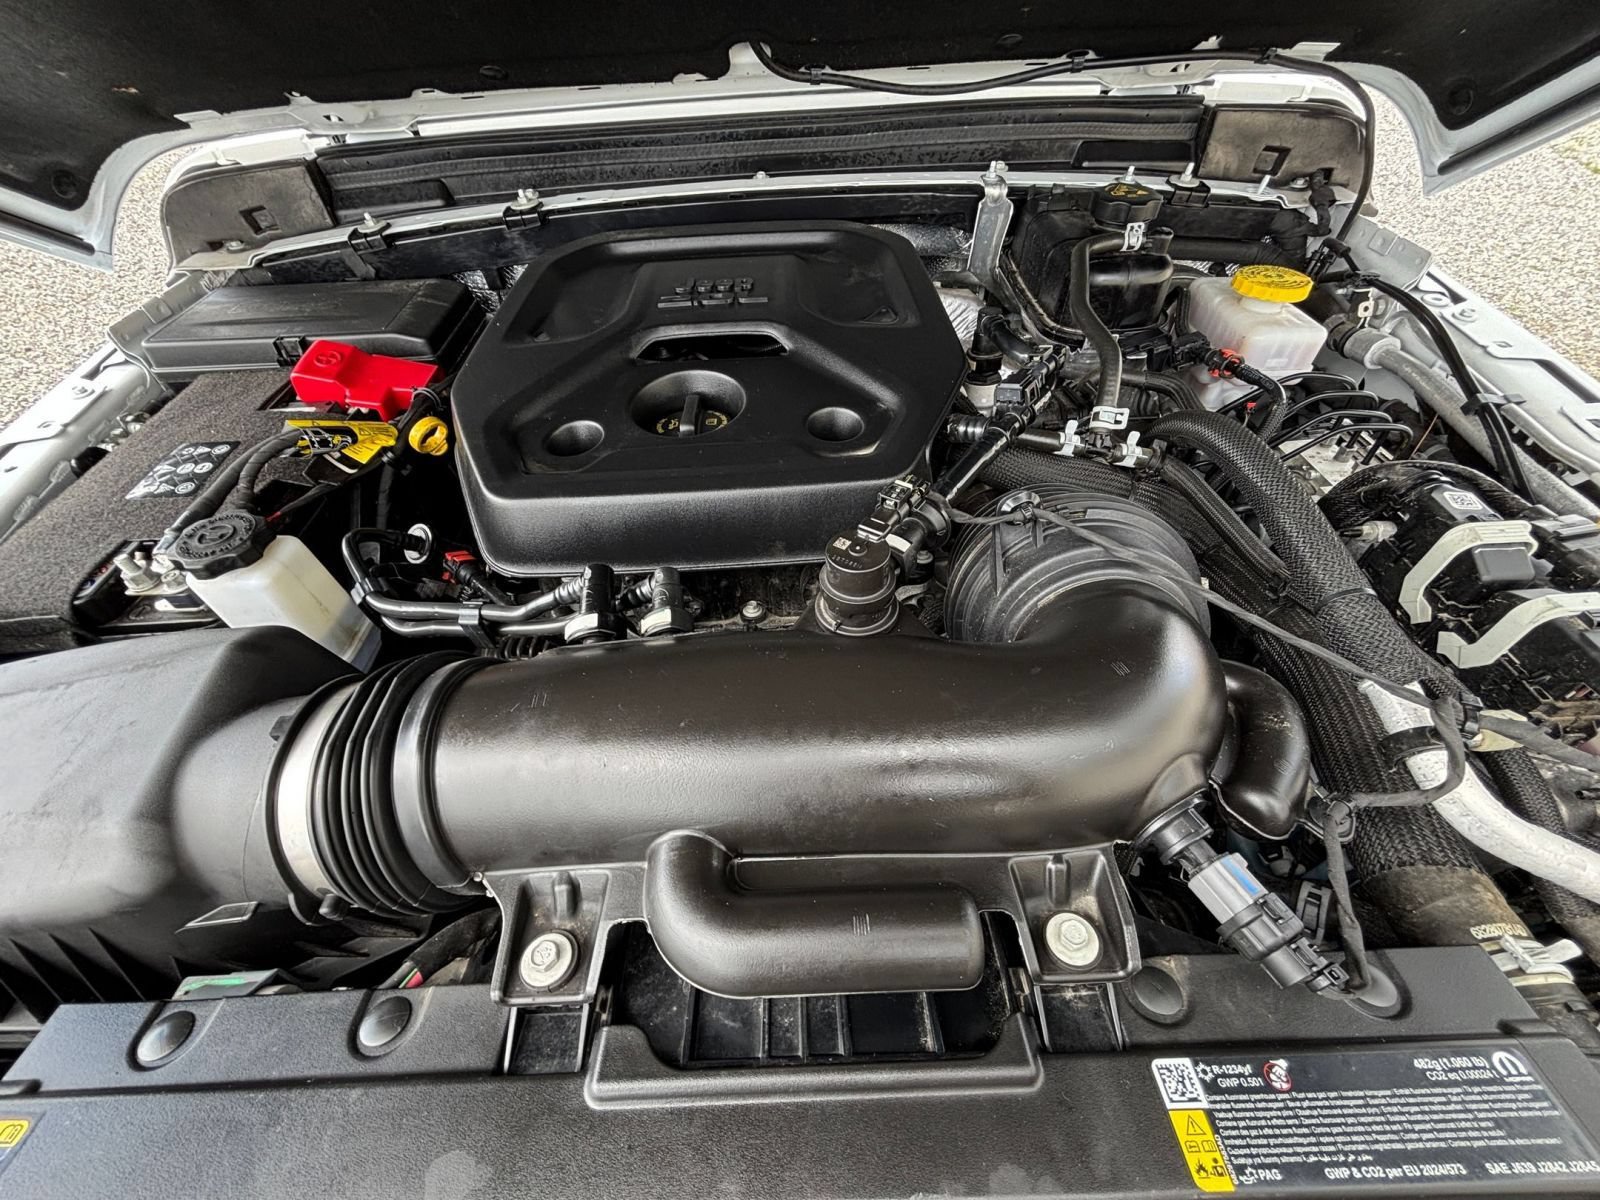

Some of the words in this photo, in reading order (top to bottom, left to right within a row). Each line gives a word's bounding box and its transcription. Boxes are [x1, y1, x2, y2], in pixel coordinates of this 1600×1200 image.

[1211, 1063, 1252, 1077] R-1234yf
[1426, 1070, 1448, 1080] CO2
[1217, 1078, 1240, 1088] GWP
[1240, 1076, 1264, 1087] 0.501
[1259, 1168, 1282, 1181] PAG
[1324, 1167, 1352, 1179] GWP
[1351, 1167, 1362, 1178] &
[1361, 1166, 1386, 1178] CO2
[1385, 1168, 1403, 1179] per
[1402, 1165, 1420, 1177] EU
[1420, 1163, 1468, 1176] 2024/573
[1484, 1162, 1511, 1175] SAE
